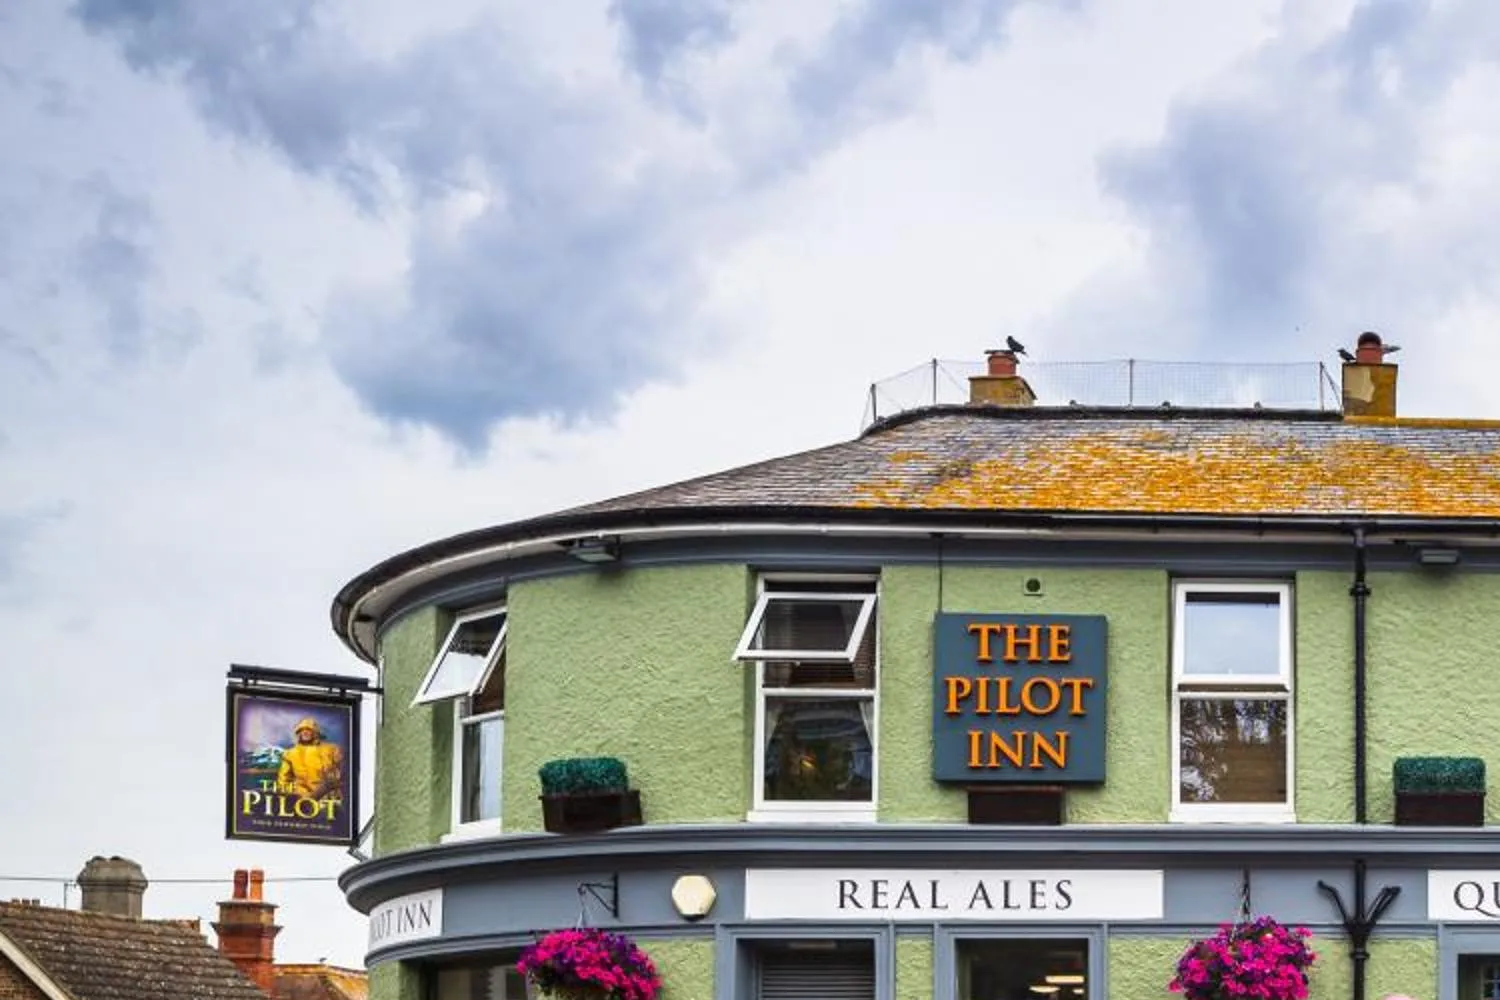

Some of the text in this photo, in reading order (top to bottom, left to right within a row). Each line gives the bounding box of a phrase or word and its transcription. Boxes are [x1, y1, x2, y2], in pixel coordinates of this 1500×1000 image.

[967, 623, 1072, 663] THE
[944, 676, 1094, 716] PILOT
[967, 730, 1069, 768] INN
[242, 789, 341, 820] PILOT
[837, 879, 1074, 910] REAL ALES
[397, 900, 433, 933] INN
